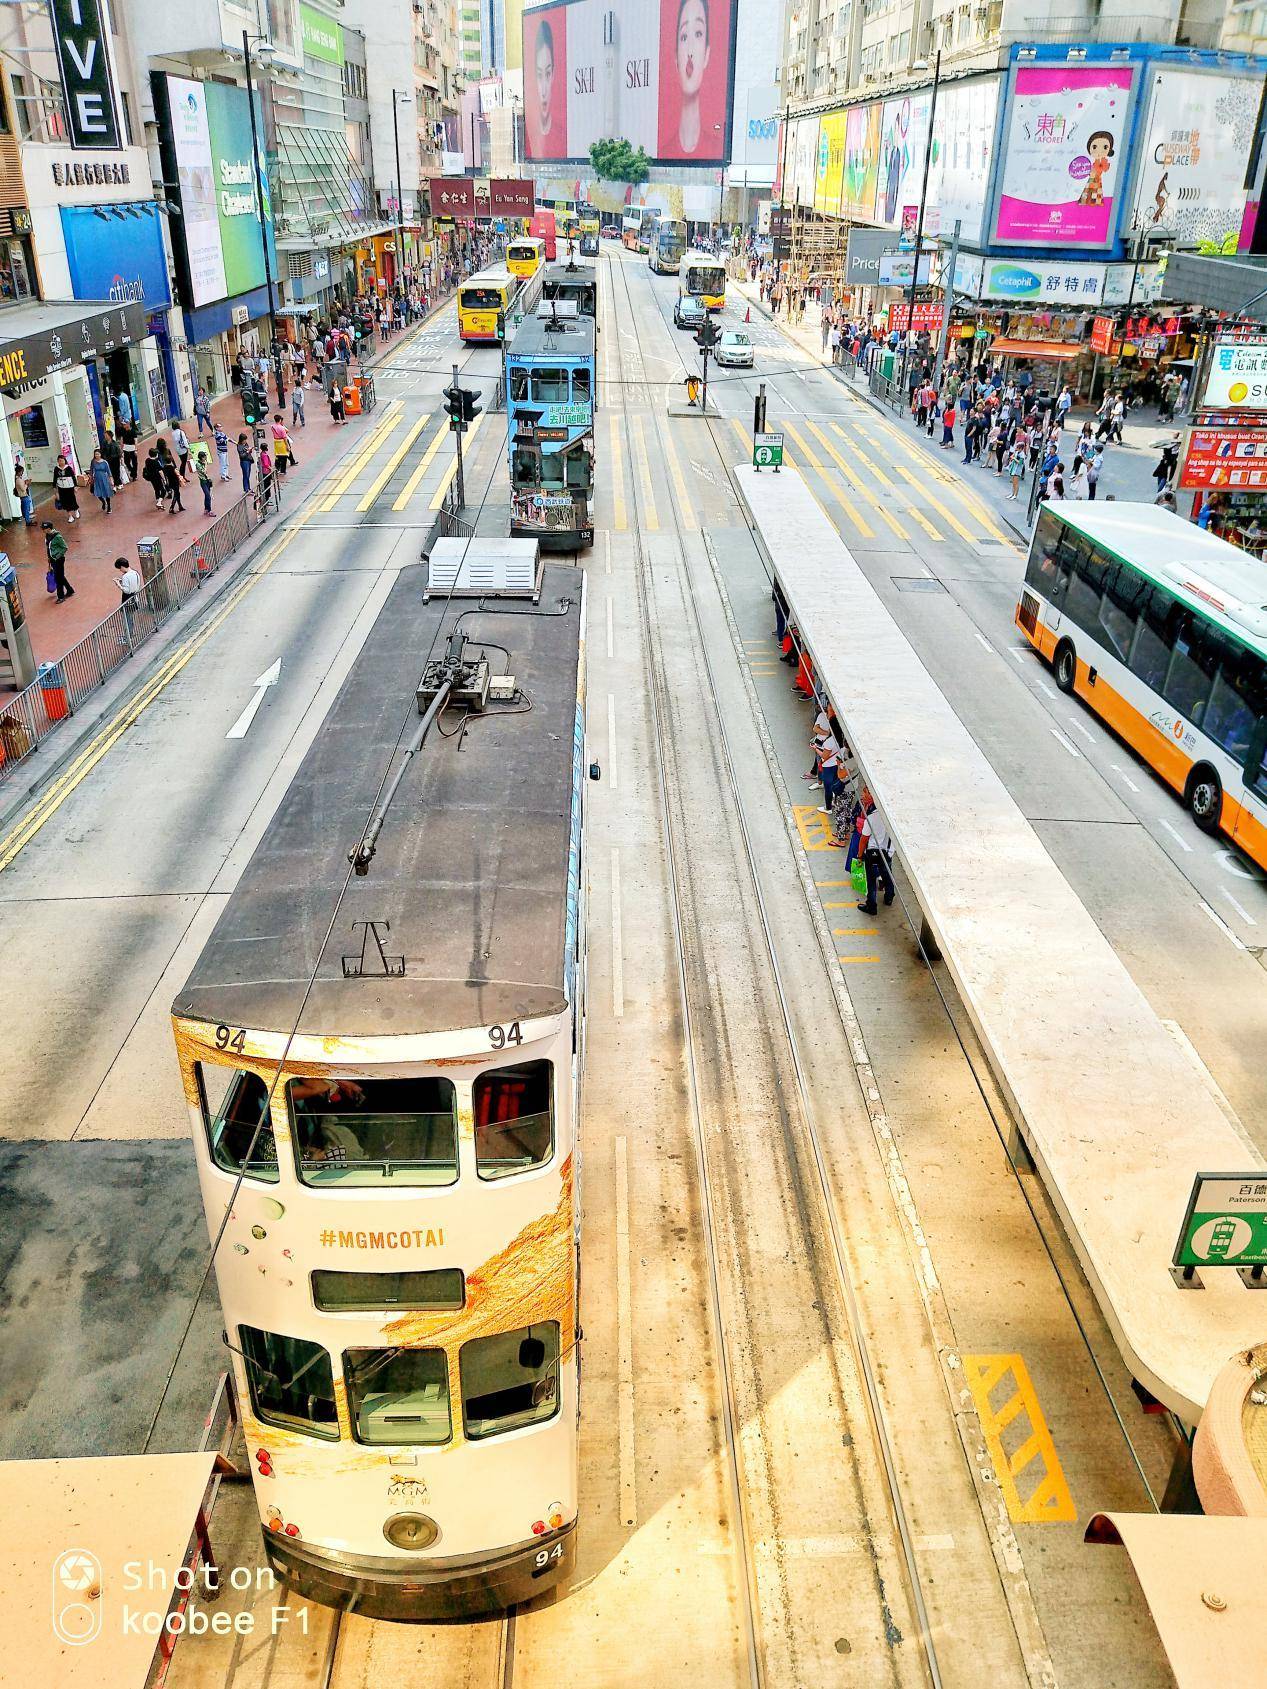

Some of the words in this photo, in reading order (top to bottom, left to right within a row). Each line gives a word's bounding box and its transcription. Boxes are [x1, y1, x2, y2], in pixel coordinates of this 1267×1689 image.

[575, 66, 595, 95] SK-II
[626, 58, 650, 89] SK-II
[109, 273, 146, 302] citibank
[998, 275, 1033, 289] Cetaphil
[1045, 275, 1098, 294] 舒特膚
[580, 531, 591, 539] 132
[215, 1024, 247, 1055] 94
[488, 1021, 525, 1052] 94
[1228, 1196, 1266, 1204] Paterson
[318, 1227, 446, 1250] #MGMCOTAI
[387, 1487, 429, 1496] MGM
[534, 1542, 565, 1568] 94
